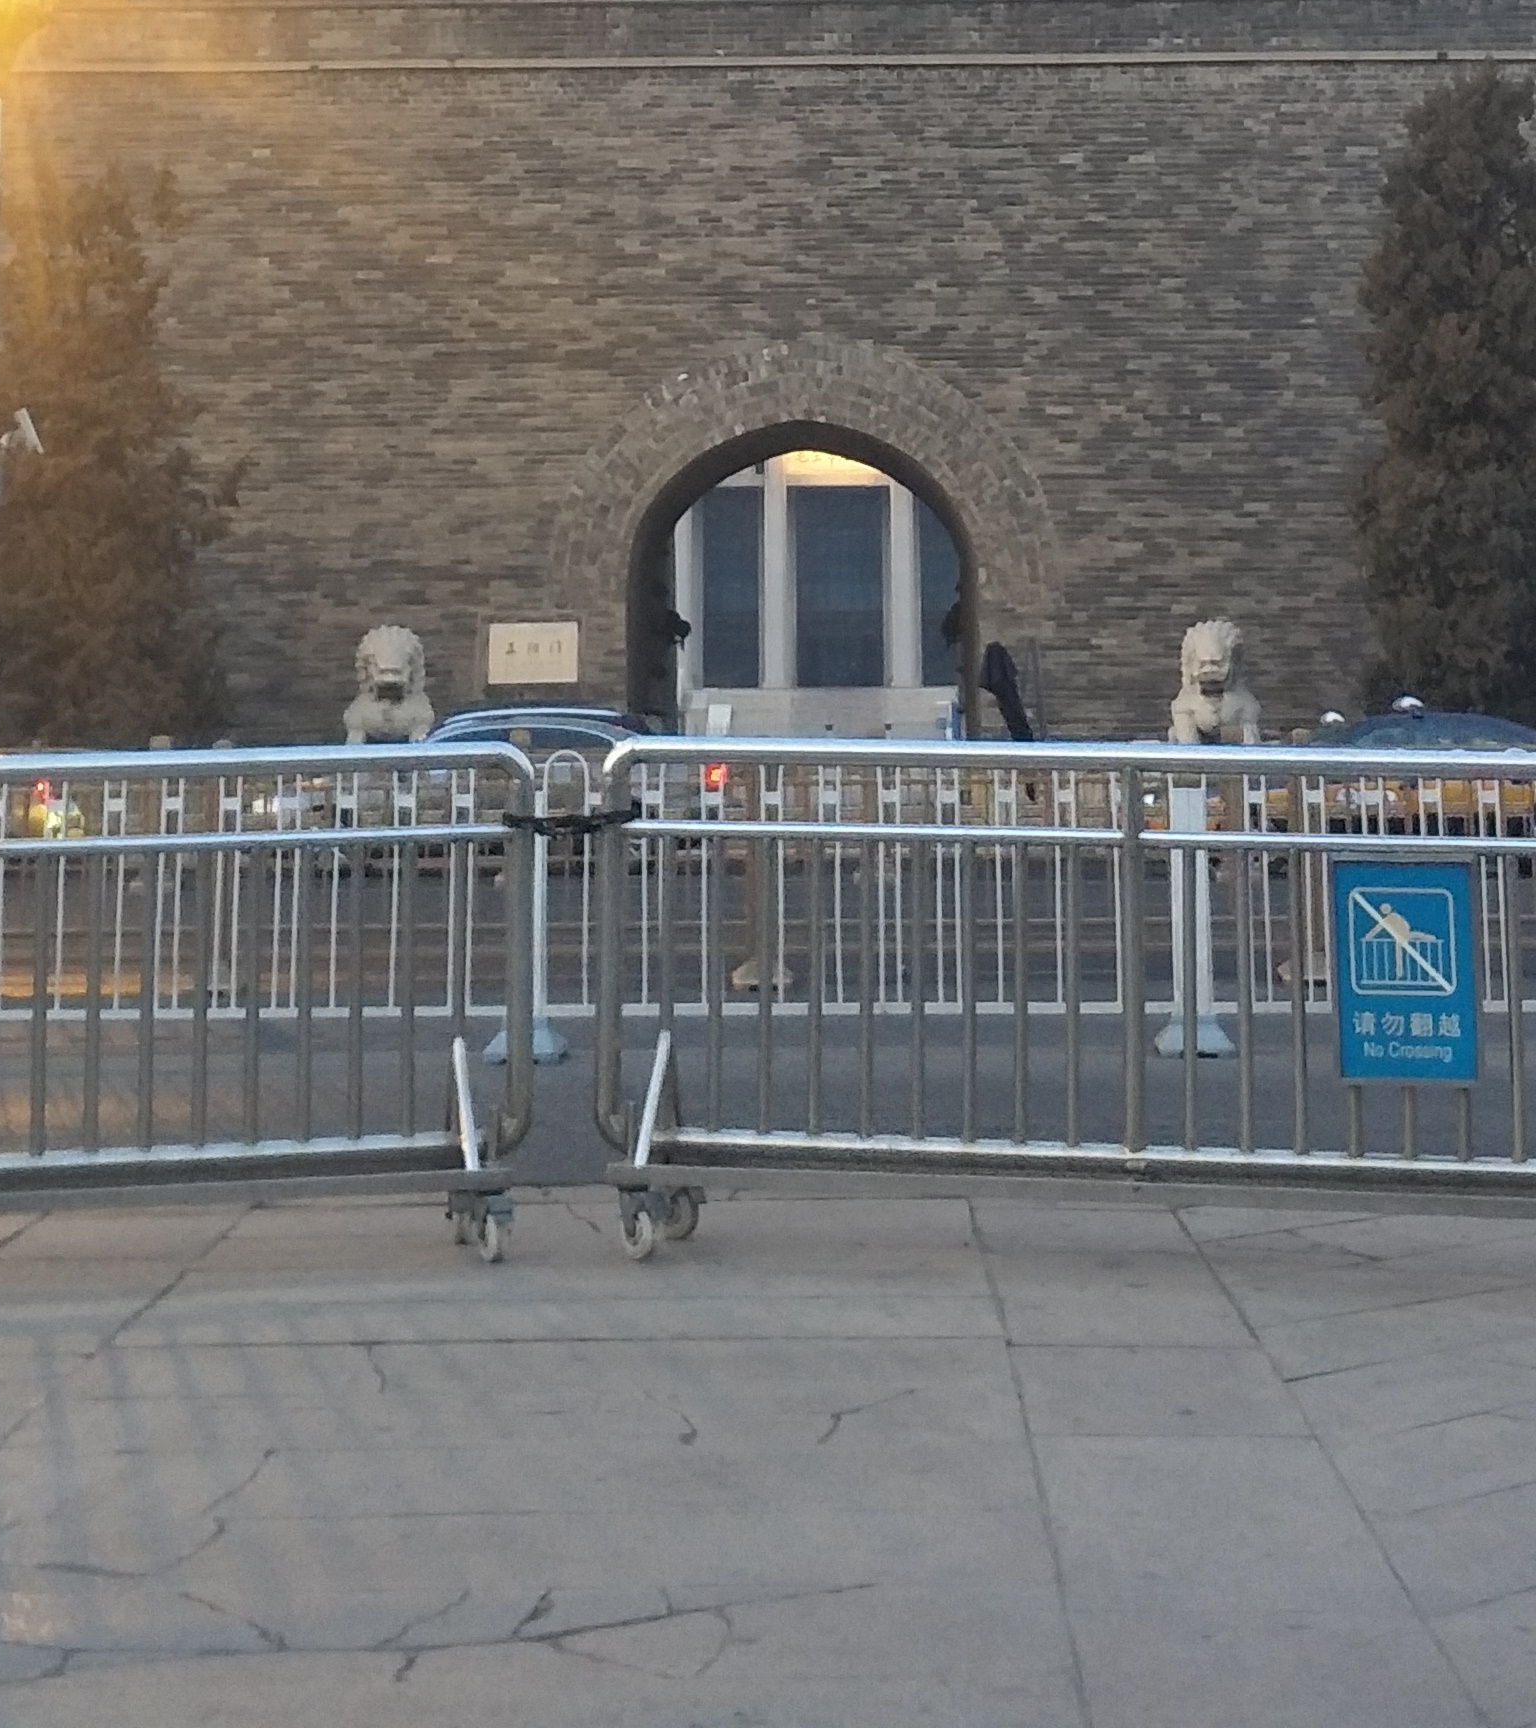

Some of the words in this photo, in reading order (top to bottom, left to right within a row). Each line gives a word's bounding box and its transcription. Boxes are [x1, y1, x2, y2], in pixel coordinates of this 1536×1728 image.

[1353, 1012, 1461, 1037] 请勿翻越
[1363, 1041, 1384, 1058] No
[1390, 1041, 1454, 1062] Crossing
